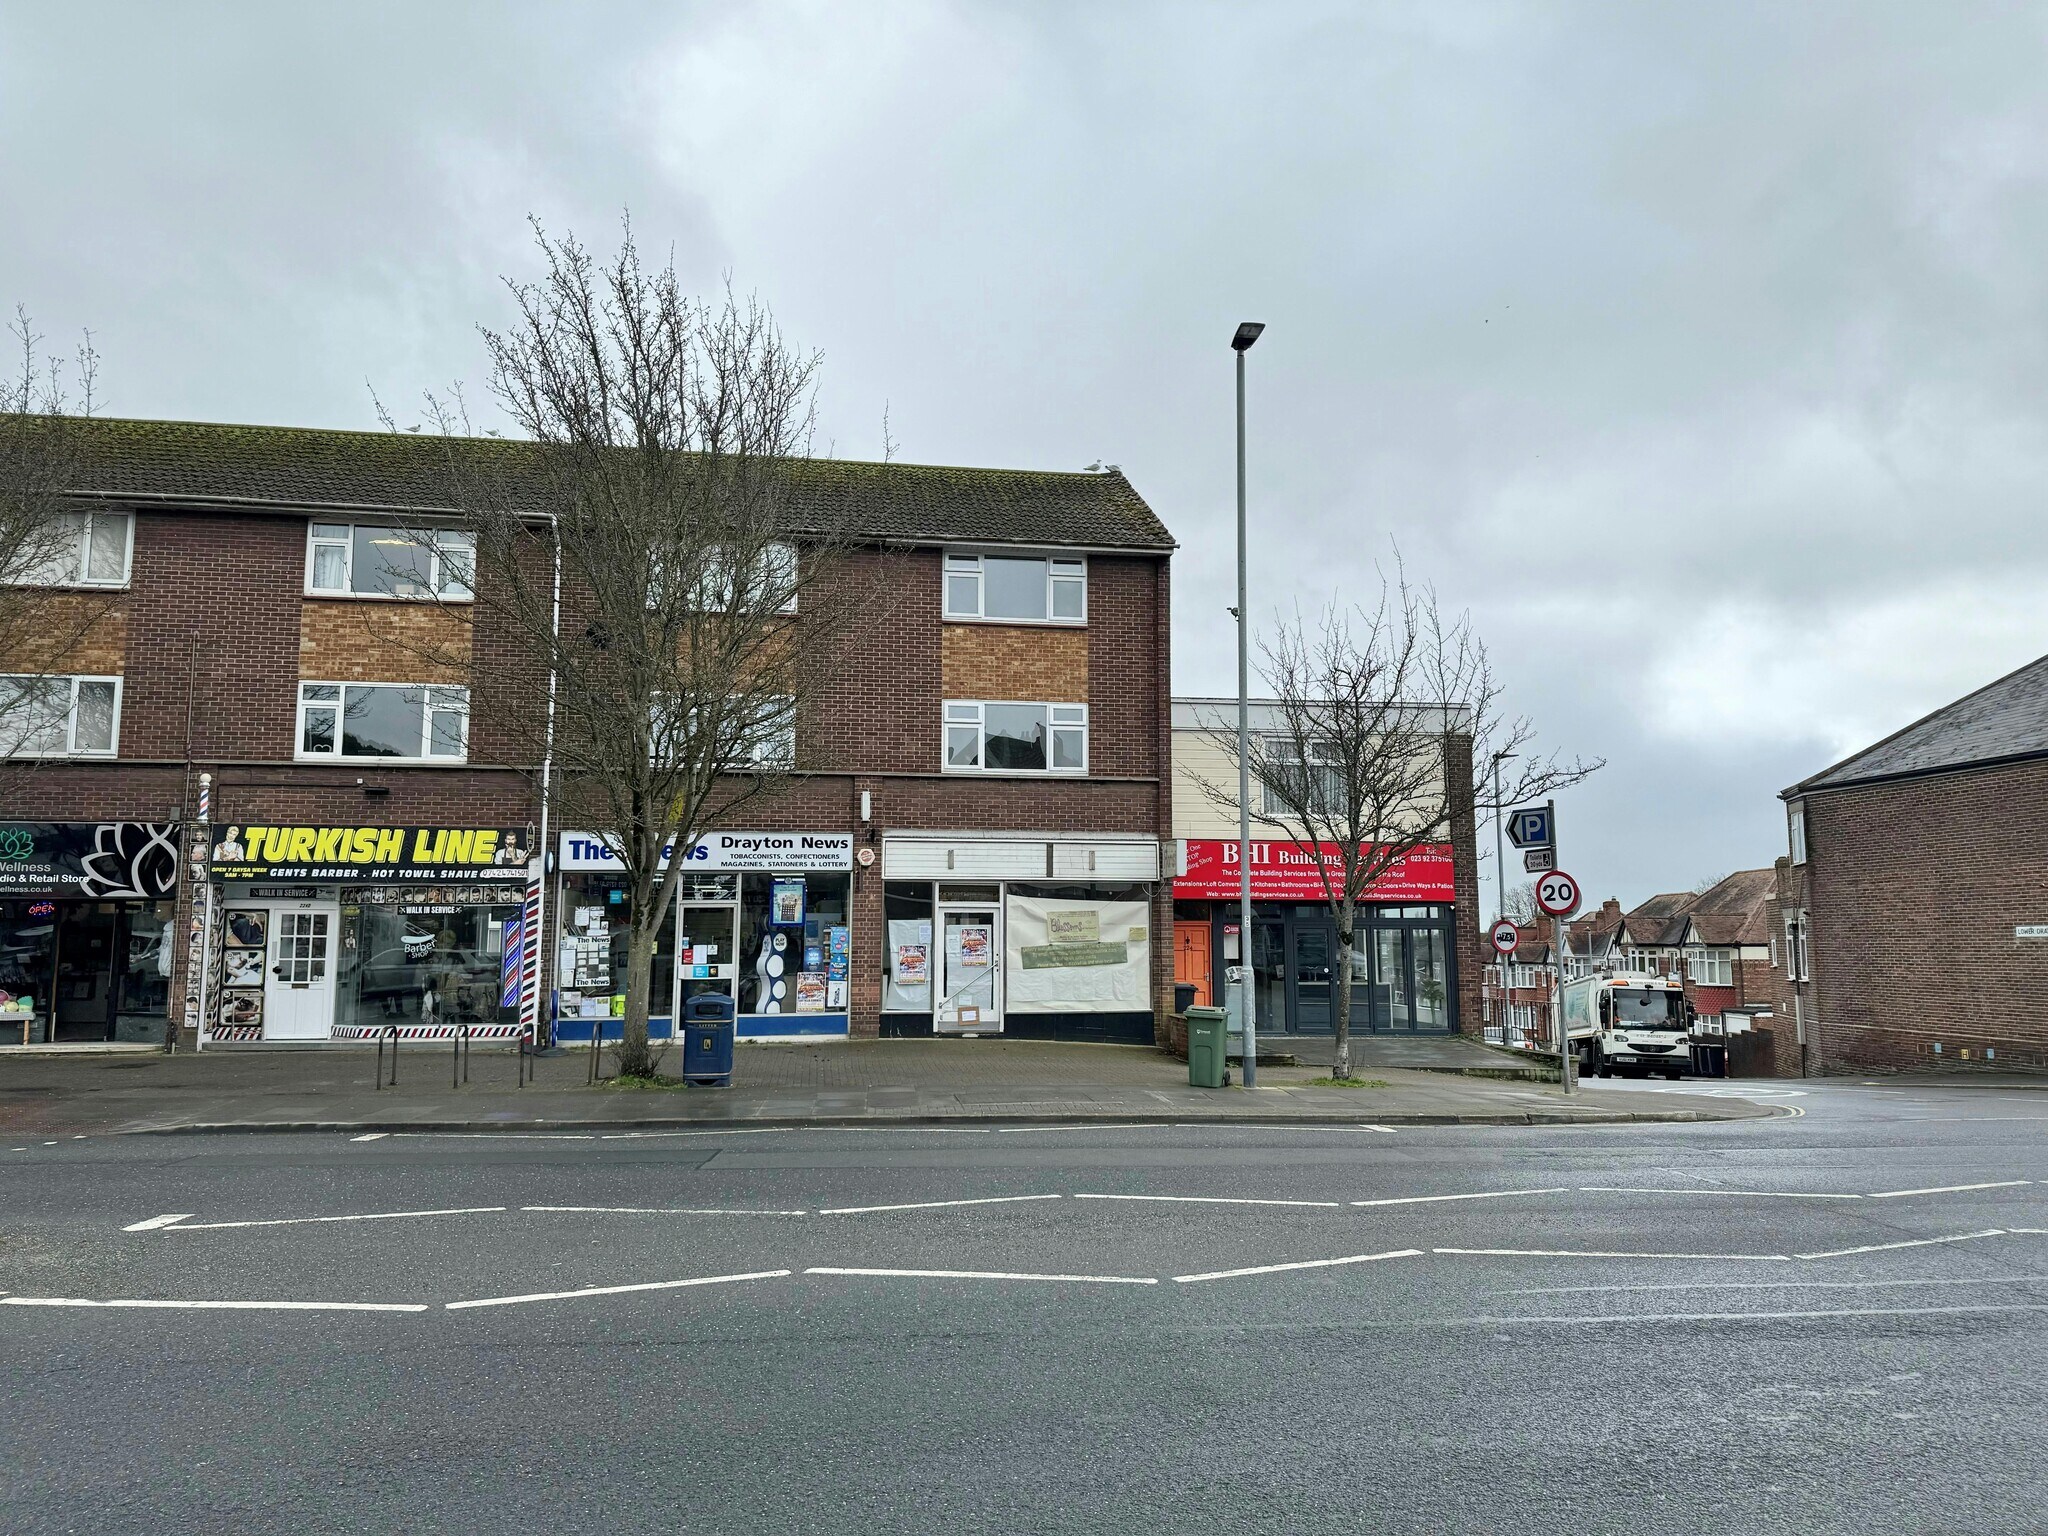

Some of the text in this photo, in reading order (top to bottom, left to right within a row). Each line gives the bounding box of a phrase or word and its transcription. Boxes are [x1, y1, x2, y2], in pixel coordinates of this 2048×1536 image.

[1526, 816, 1541, 840] P
[244, 826, 405, 863] TURKISH
[412, 829, 499, 864] LINE
[721, 836, 849, 851] Drayton News
[569, 840, 614, 860] The
[0, 874, 16, 882] dio
[270, 868, 358, 878] GENTS BARBER
[372, 870, 478, 878] HOT TOWEL SHAVE
[1260, 870, 1282, 878] Building
[258, 888, 308, 896] WALK IN SERVICE
[1542, 884, 1572, 901] 20
[29, 903, 56, 914] OPEN
[406, 906, 455, 914] WALK IN SERVICE
[404, 940, 436, 952] Barber
[412, 950, 428, 958] SHOP
